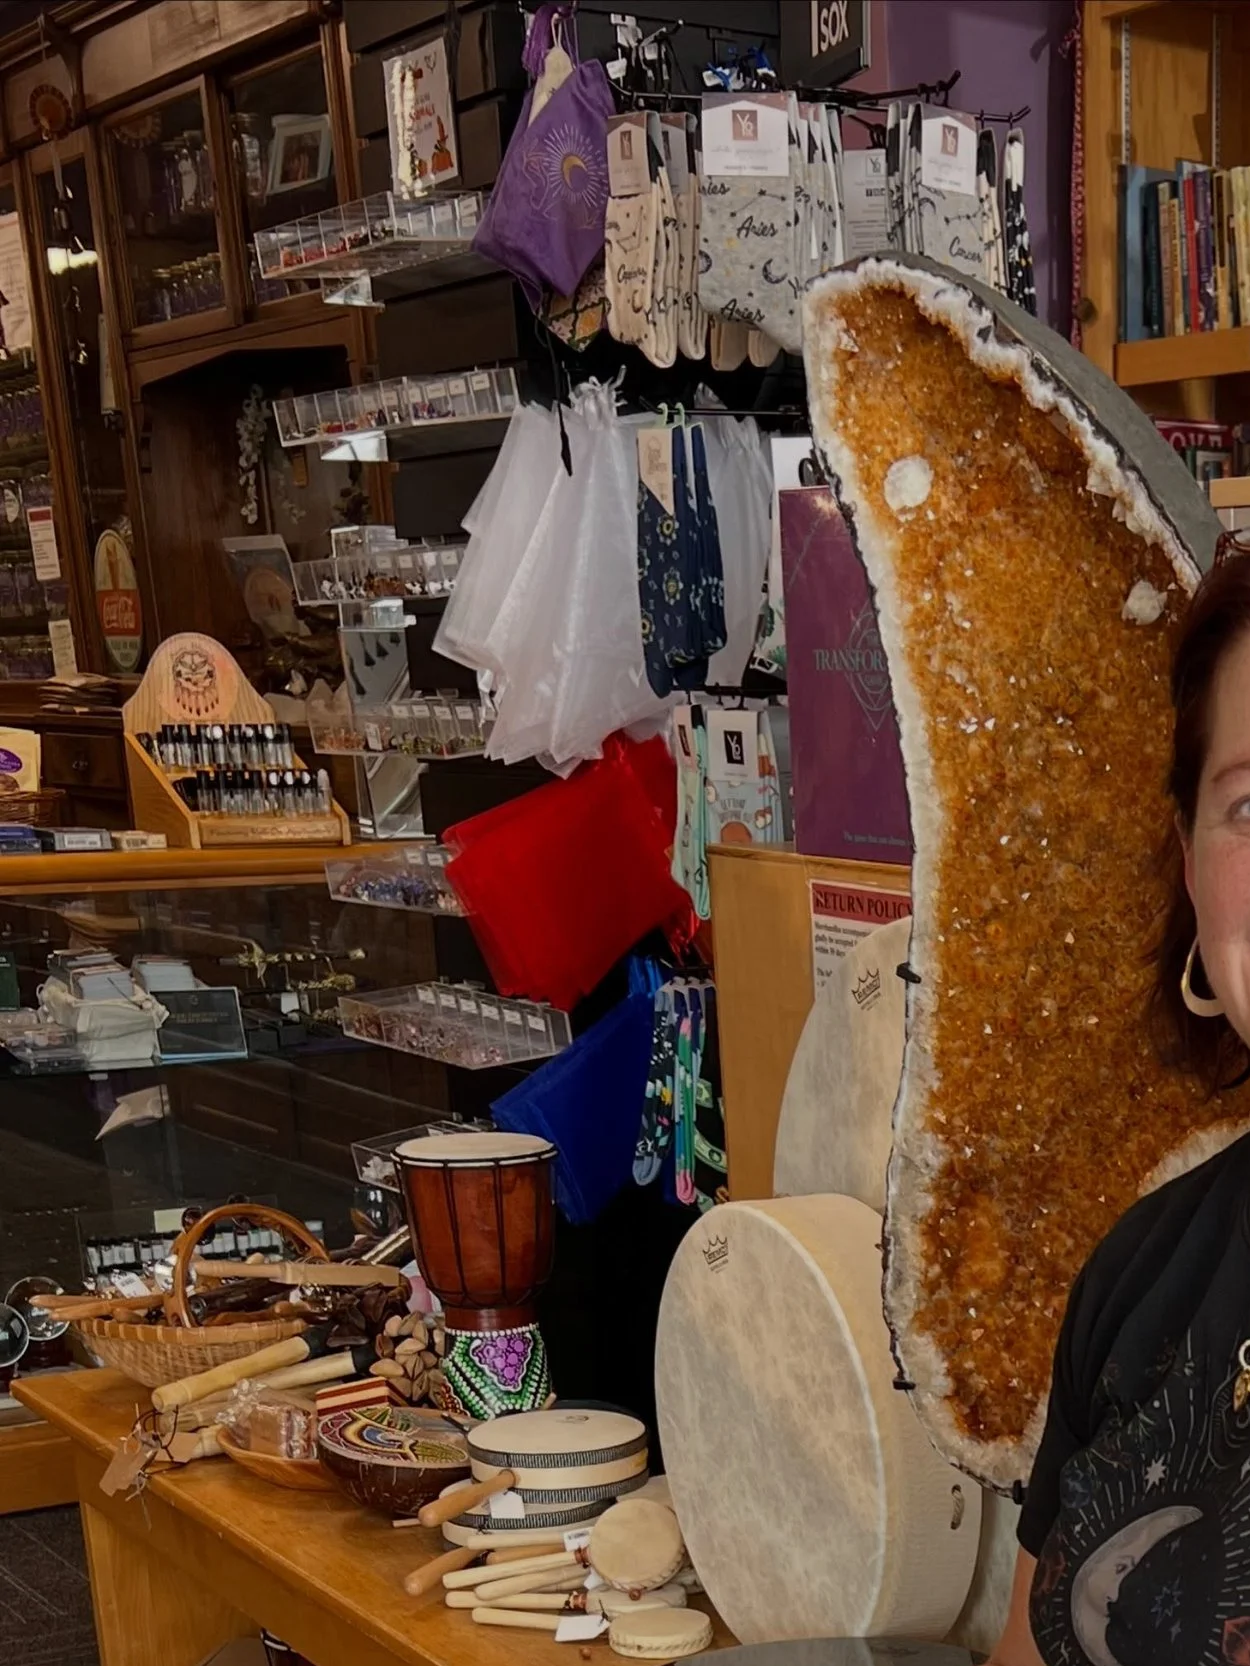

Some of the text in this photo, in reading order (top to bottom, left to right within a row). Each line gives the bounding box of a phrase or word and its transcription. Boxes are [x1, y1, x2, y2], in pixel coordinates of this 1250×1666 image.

[737, 215, 778, 239] Aries
[720, 298, 766, 323] Aries
[815, 890, 864, 914] RETURN
